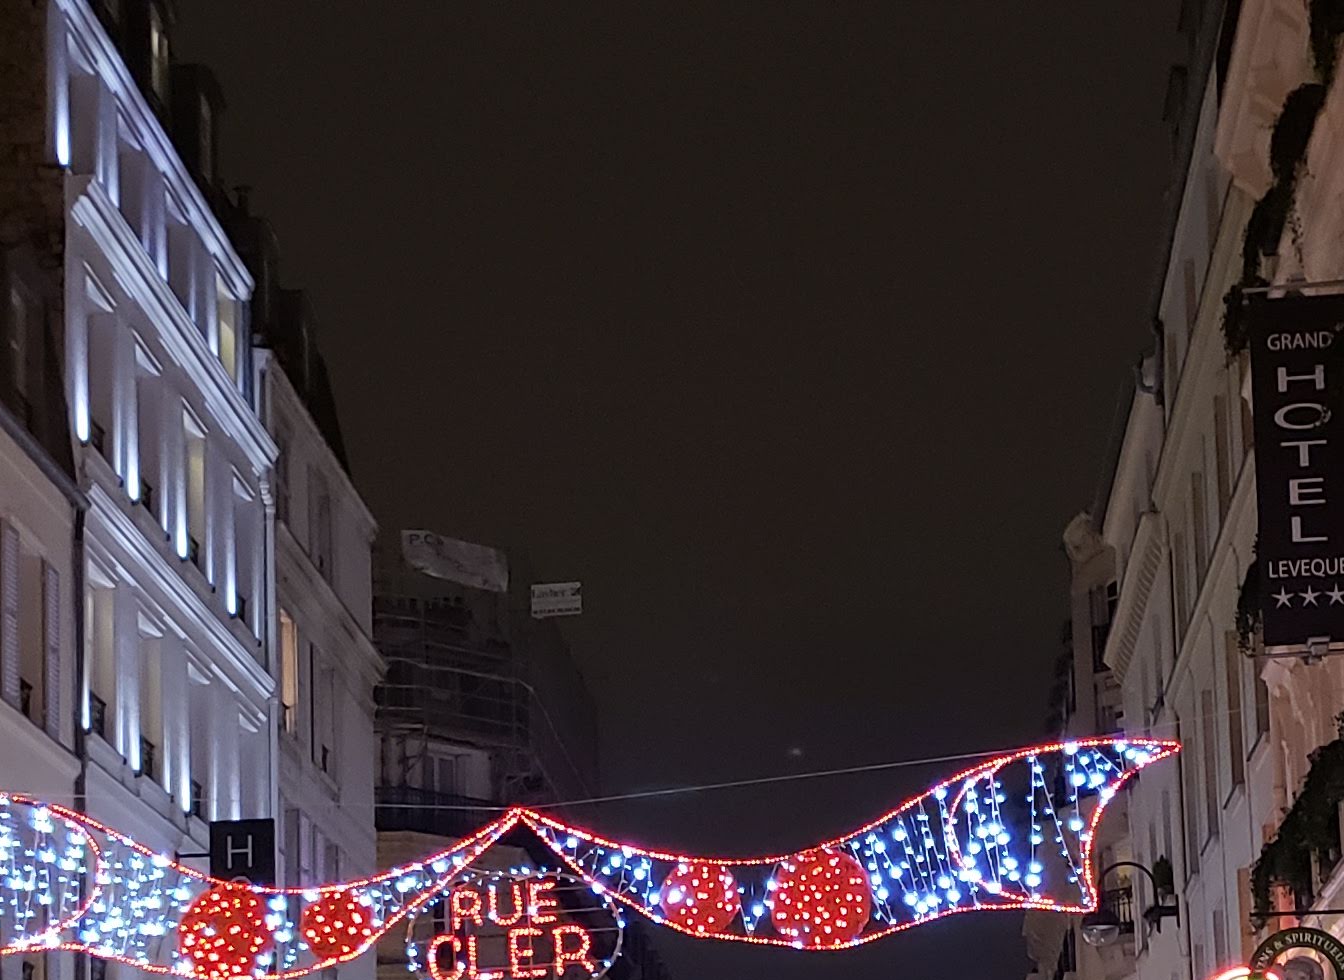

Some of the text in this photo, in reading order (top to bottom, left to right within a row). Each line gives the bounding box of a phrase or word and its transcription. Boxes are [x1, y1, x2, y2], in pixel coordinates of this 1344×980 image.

[1267, 330, 1334, 351] GRAND
[1274, 364, 1332, 544] HOTEL
[450, 881, 558, 930] RUE
